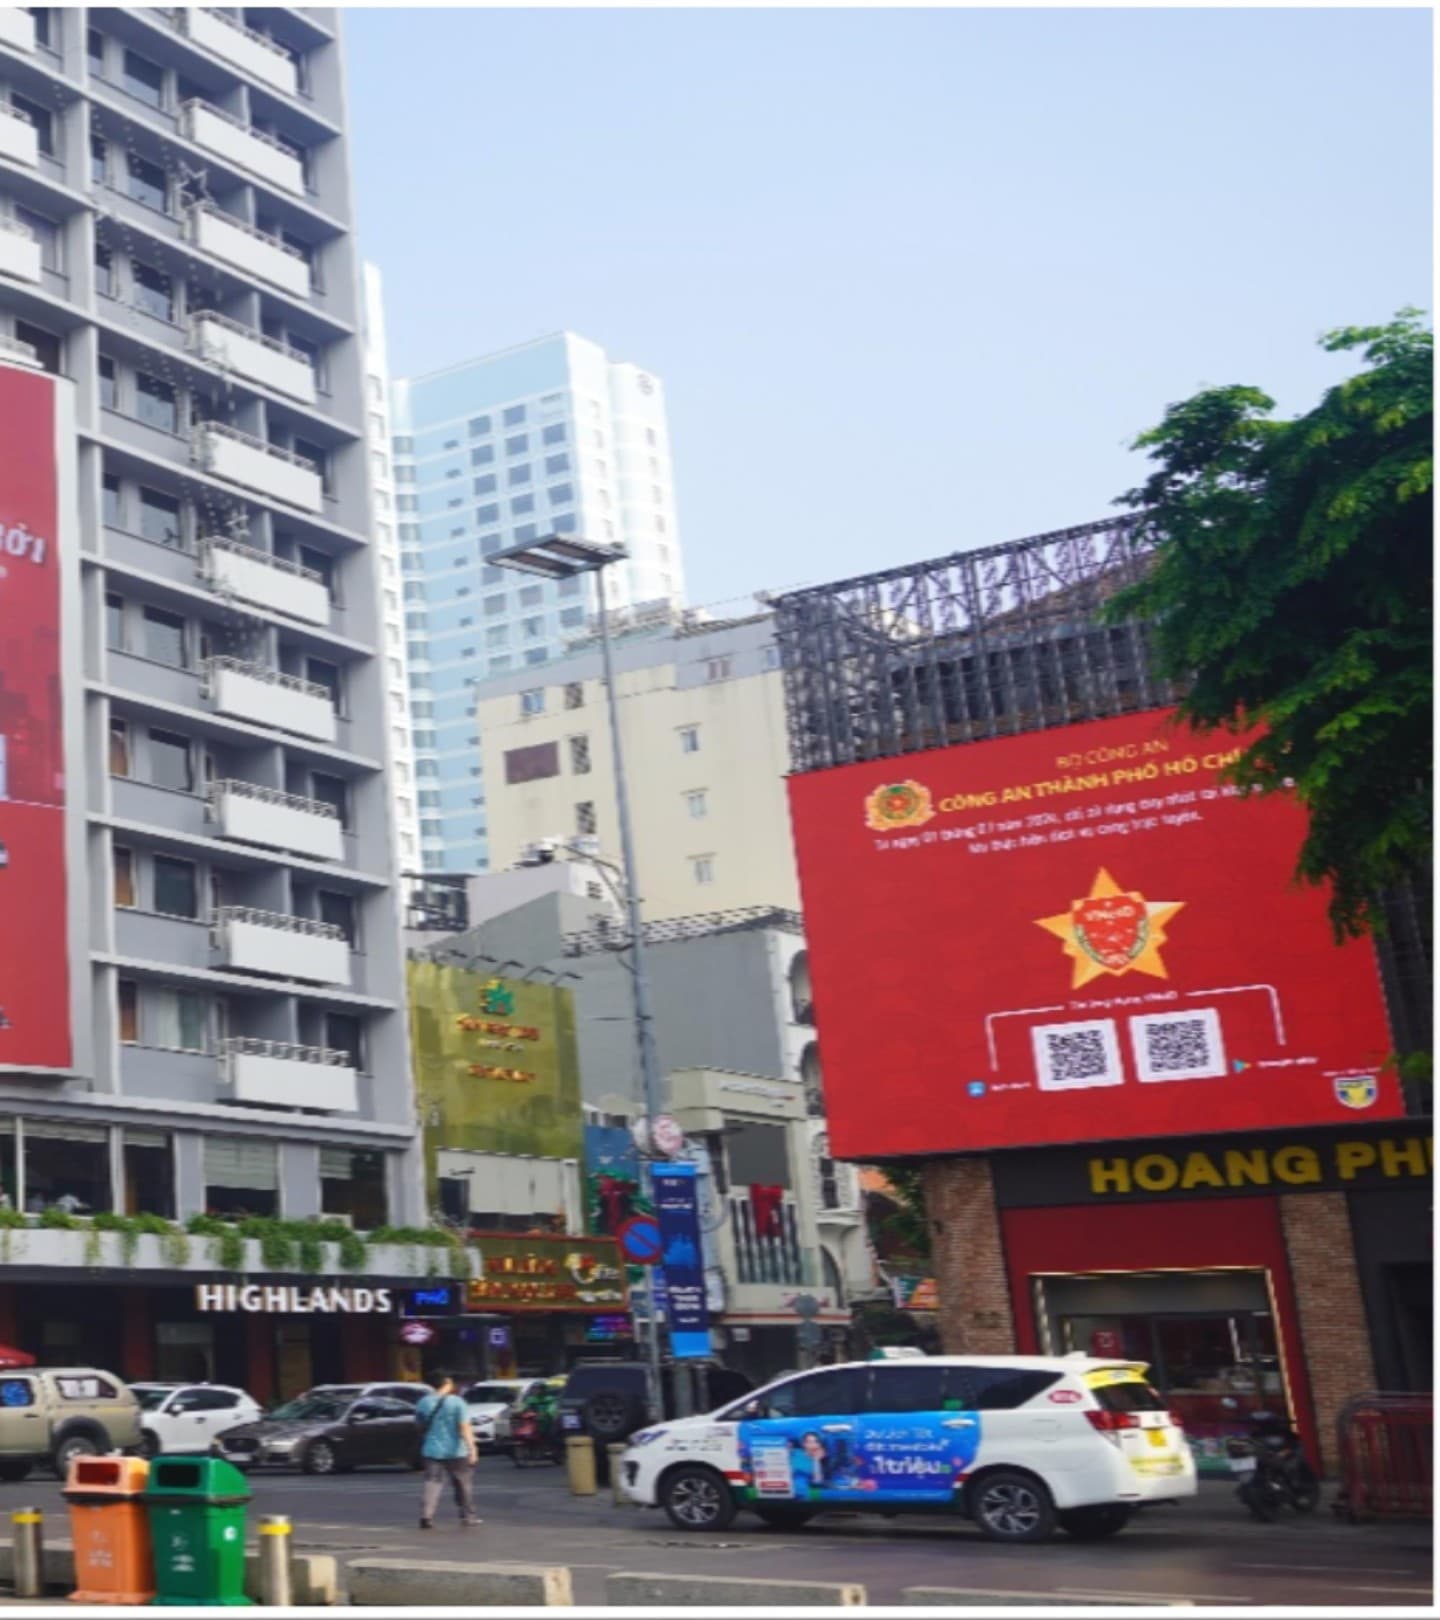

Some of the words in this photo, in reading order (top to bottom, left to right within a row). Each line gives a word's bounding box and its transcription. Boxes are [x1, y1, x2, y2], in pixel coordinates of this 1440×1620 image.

[939, 790, 997, 812] CÔNG
[1001, 785, 1032, 803] AN
[1034, 773, 1109, 798] THÀNH
[1112, 763, 1159, 785] PHỐ
[1163, 755, 1198, 776] HỒ
[1088, 1145, 1322, 1193] HOANG
[1335, 1136, 1433, 1180] PH
[195, 1284, 391, 1313] HIGHLANDS
